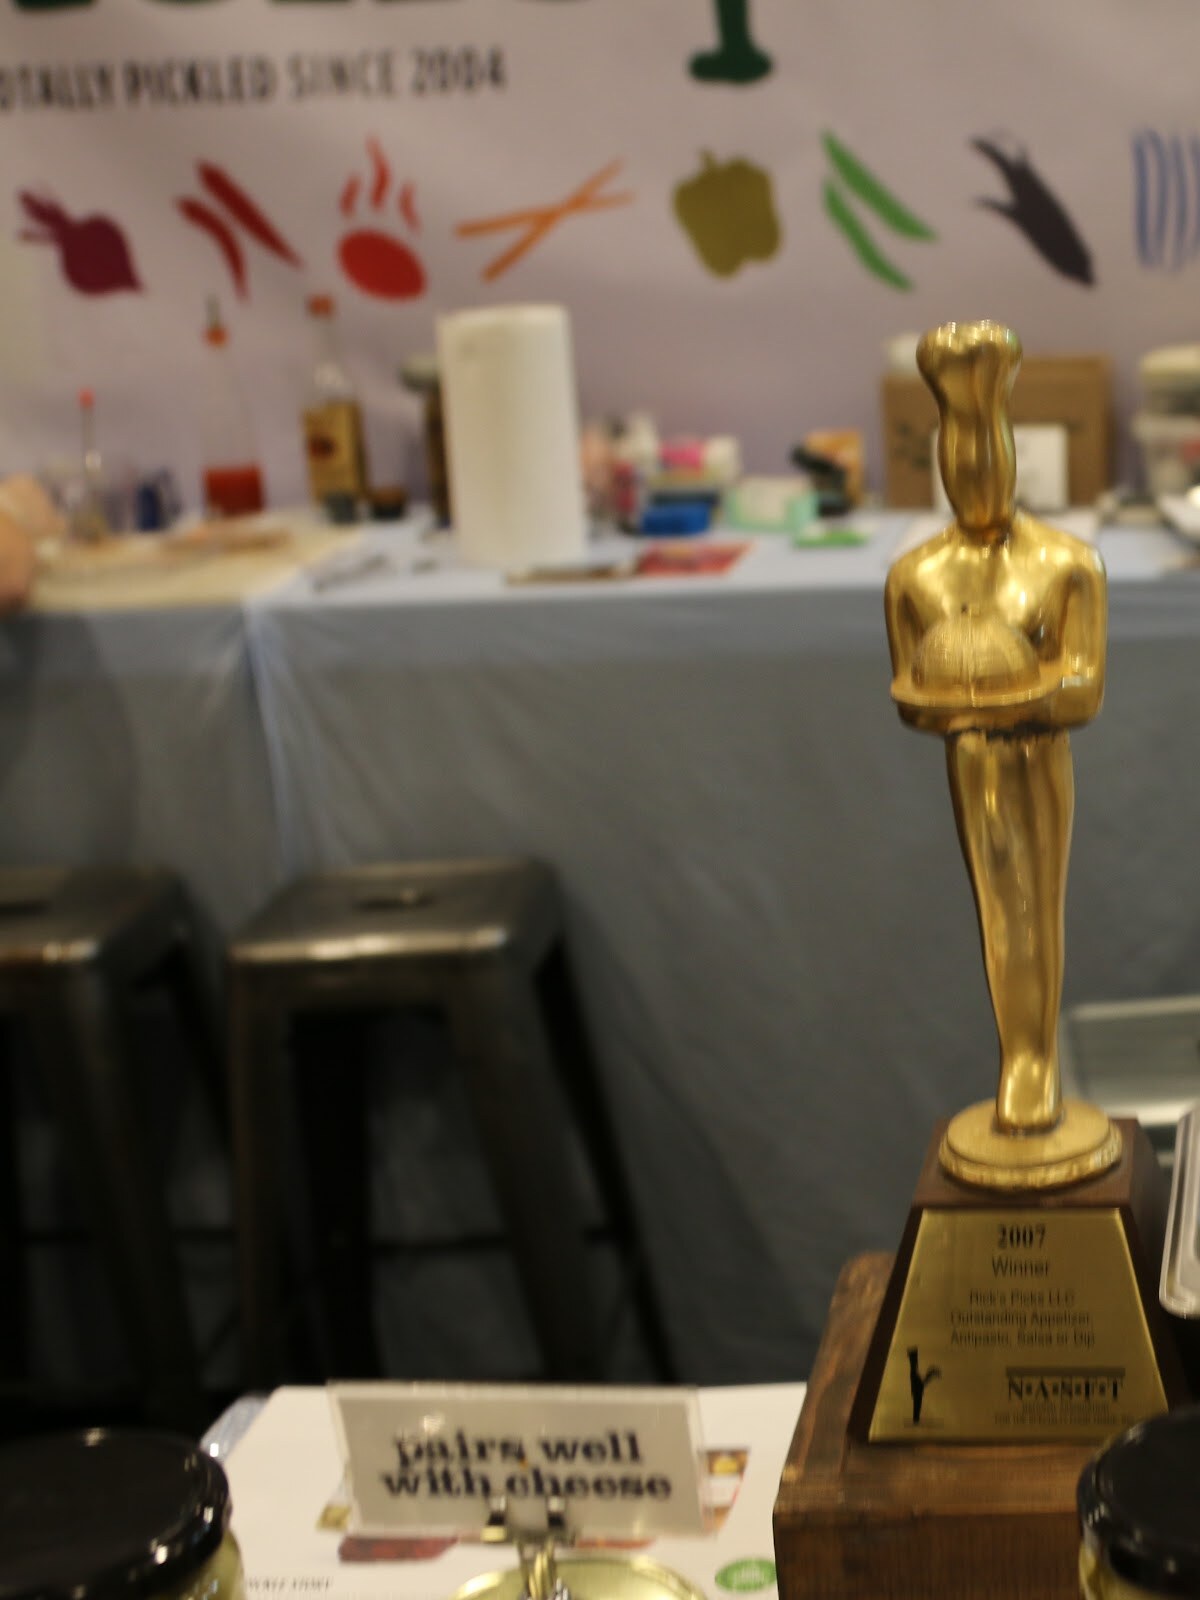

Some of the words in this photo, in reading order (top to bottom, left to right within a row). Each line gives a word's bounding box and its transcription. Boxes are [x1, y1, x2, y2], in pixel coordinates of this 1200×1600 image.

[122, 55, 277, 104] PICKLED
[287, 48, 396, 98] SINCE
[410, 42, 508, 95] 2004
[998, 1224, 1046, 1249] 2007
[992, 1256, 1048, 1278] Winner
[395, 1429, 526, 1468] pairs
[541, 1429, 642, 1463] well
[381, 1467, 492, 1497] with
[505, 1467, 672, 1499] cheese
